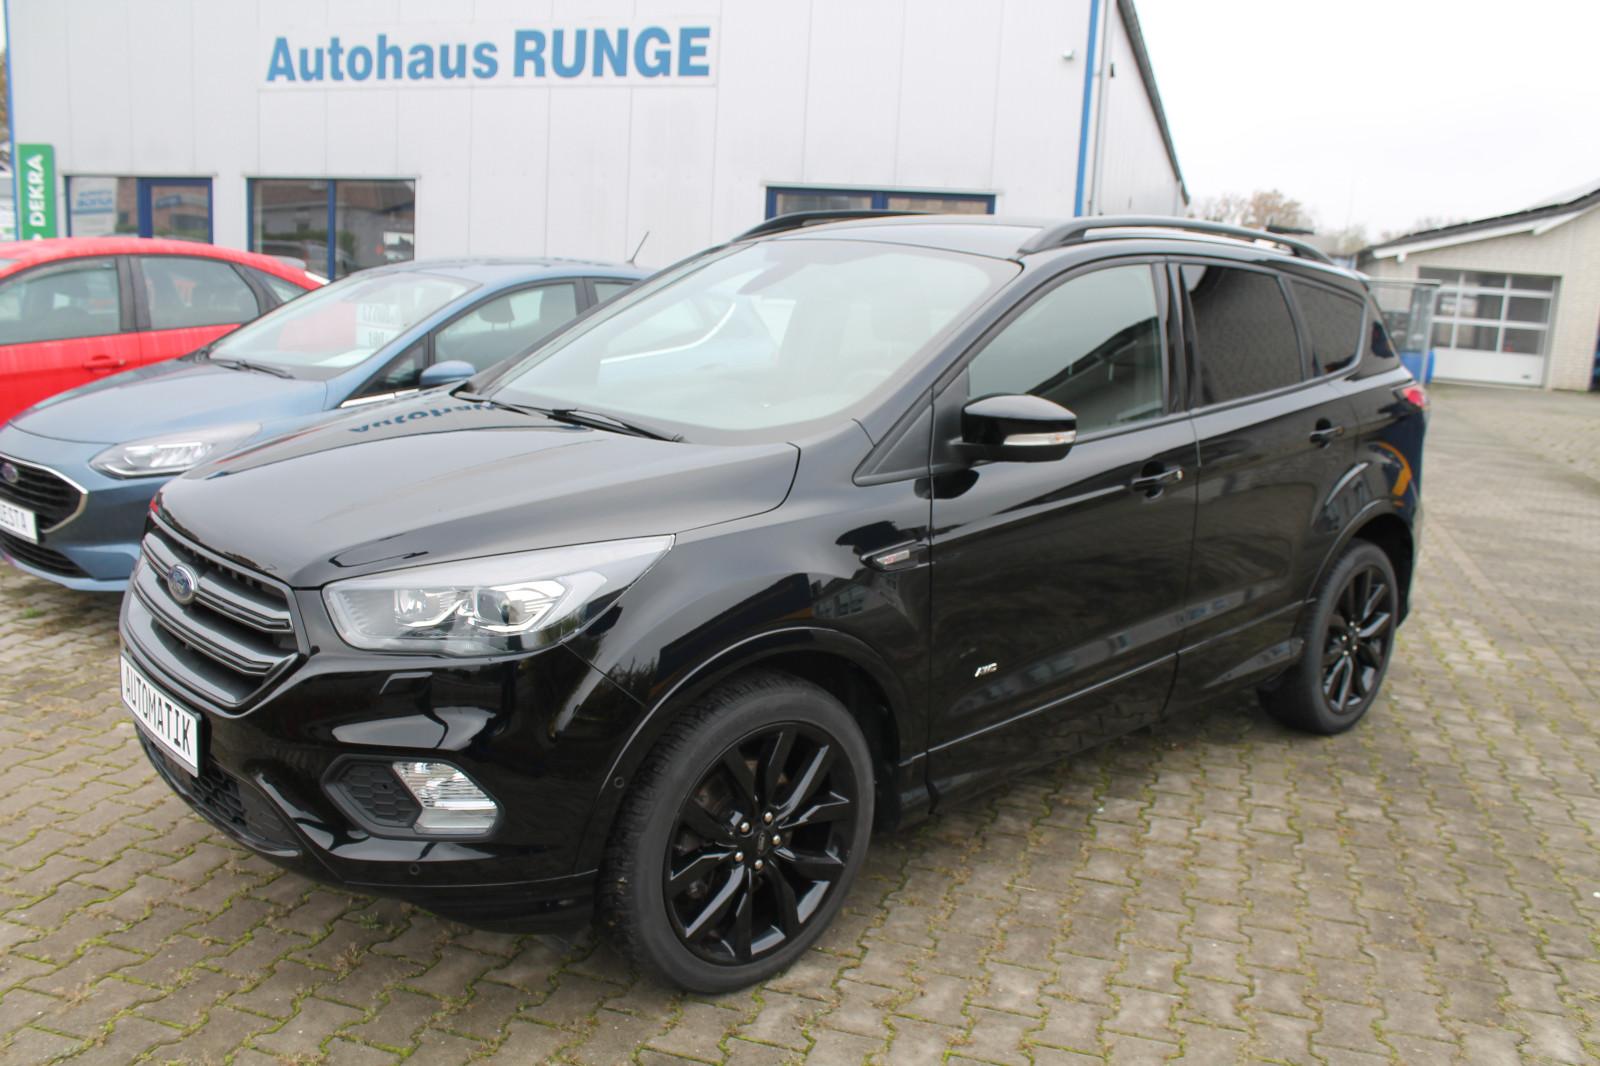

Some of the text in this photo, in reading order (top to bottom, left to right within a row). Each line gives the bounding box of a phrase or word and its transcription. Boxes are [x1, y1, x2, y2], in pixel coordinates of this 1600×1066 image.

[266, 24, 711, 82] Autohaus RUNGE
[26, 154, 46, 227] DEKRA
[126, 666, 191, 756] AUTOMATIK
